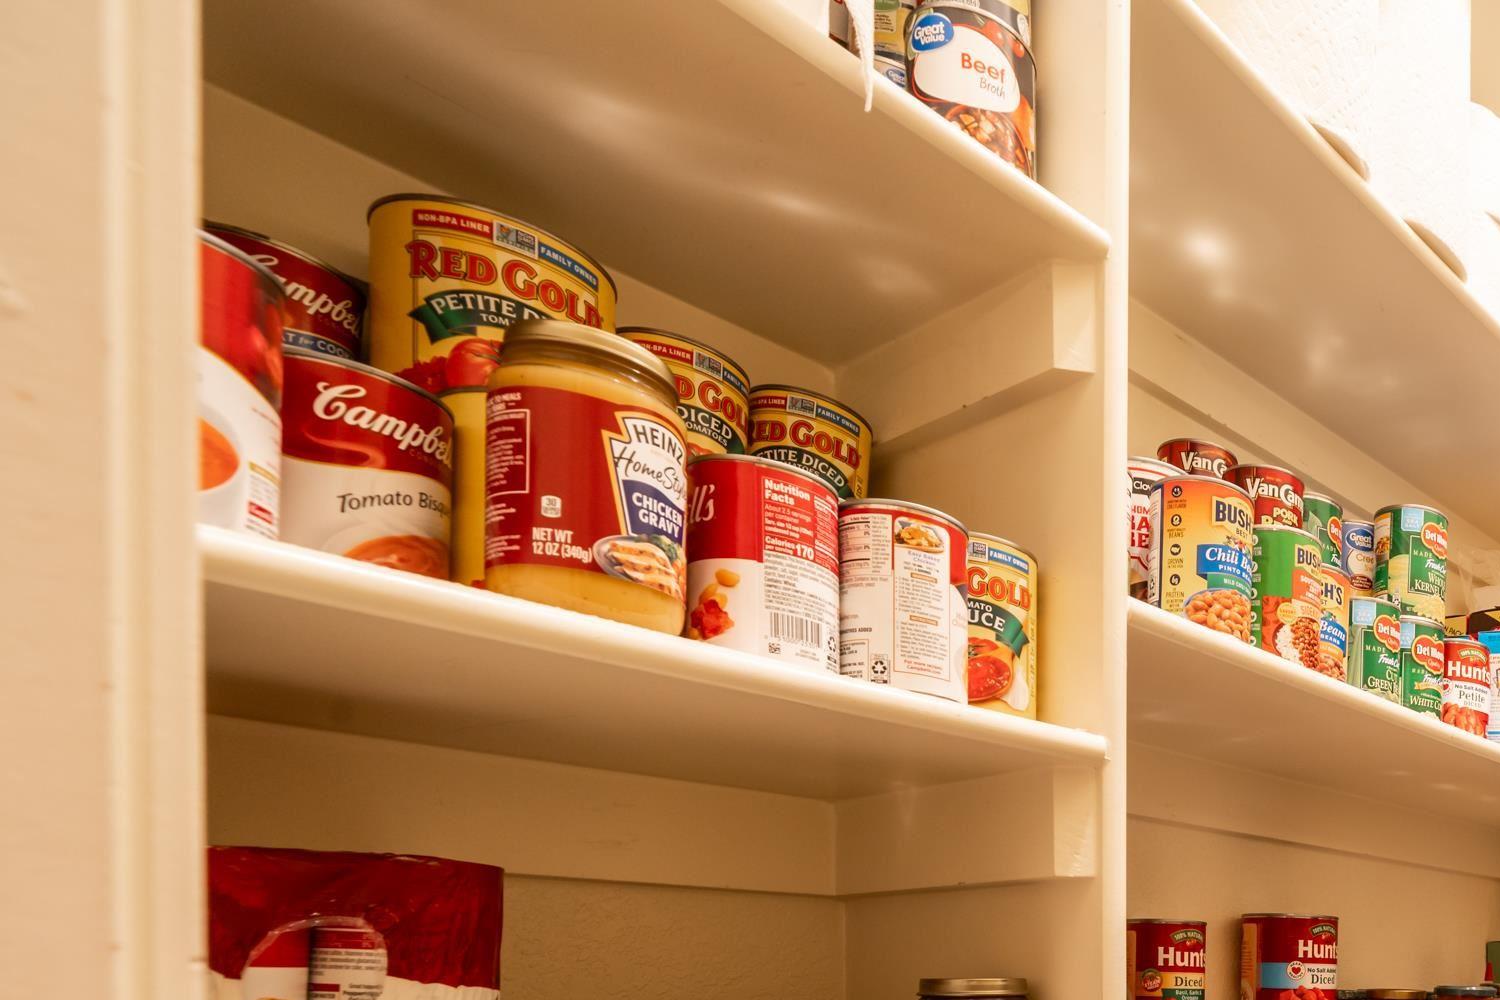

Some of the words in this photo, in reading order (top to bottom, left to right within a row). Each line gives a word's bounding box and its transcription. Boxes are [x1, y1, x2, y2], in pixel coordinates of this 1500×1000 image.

[914, 21, 945, 40] Great
[919, 33, 945, 45] Value
[961, 52, 1006, 84] Beef
[979, 77, 1006, 98] Broth
[417, 212, 458, 226] NON-BPA
[460, 219, 491, 234] LINER
[541, 246, 573, 268] FAMILY
[405, 239, 498, 286] RED
[502, 260, 602, 329] GOLD
[430, 293, 517, 318] PETITE
[669, 348, 691, 360] LINER
[817, 407, 840, 421] FAMILY
[633, 423, 684, 466] HEINZ
[789, 419, 861, 470] GOLD
[802, 453, 845, 487] DICED
[764, 478, 811, 502] Nutrition
[764, 489, 795, 506] Facts
[336, 492, 413, 513] Tomato
[632, 491, 683, 527] CHICKEN
[638, 509, 681, 539] GRAVY
[1273, 507, 1299, 526] PORK
[532, 527, 552, 542] NET
[554, 530, 574, 544] WT
[532, 541, 544, 555] 12
[545, 542, 559, 556] OZ
[764, 536, 796, 550] Calories
[796, 544, 815, 560] 170
[990, 550, 1012, 564] FAMILY
[1205, 547, 1239, 565] Chili
[1218, 565, 1241, 575] PINTO
[968, 566, 1031, 611] GOLD
[1414, 580, 1440, 597] KERNEL
[1368, 676, 1392, 692] GREEN
[1410, 695, 1434, 709] WHITE
[1459, 690, 1486, 703] Petite
[1174, 976, 1203, 987] Diced
[1311, 974, 1335, 985] Diced
